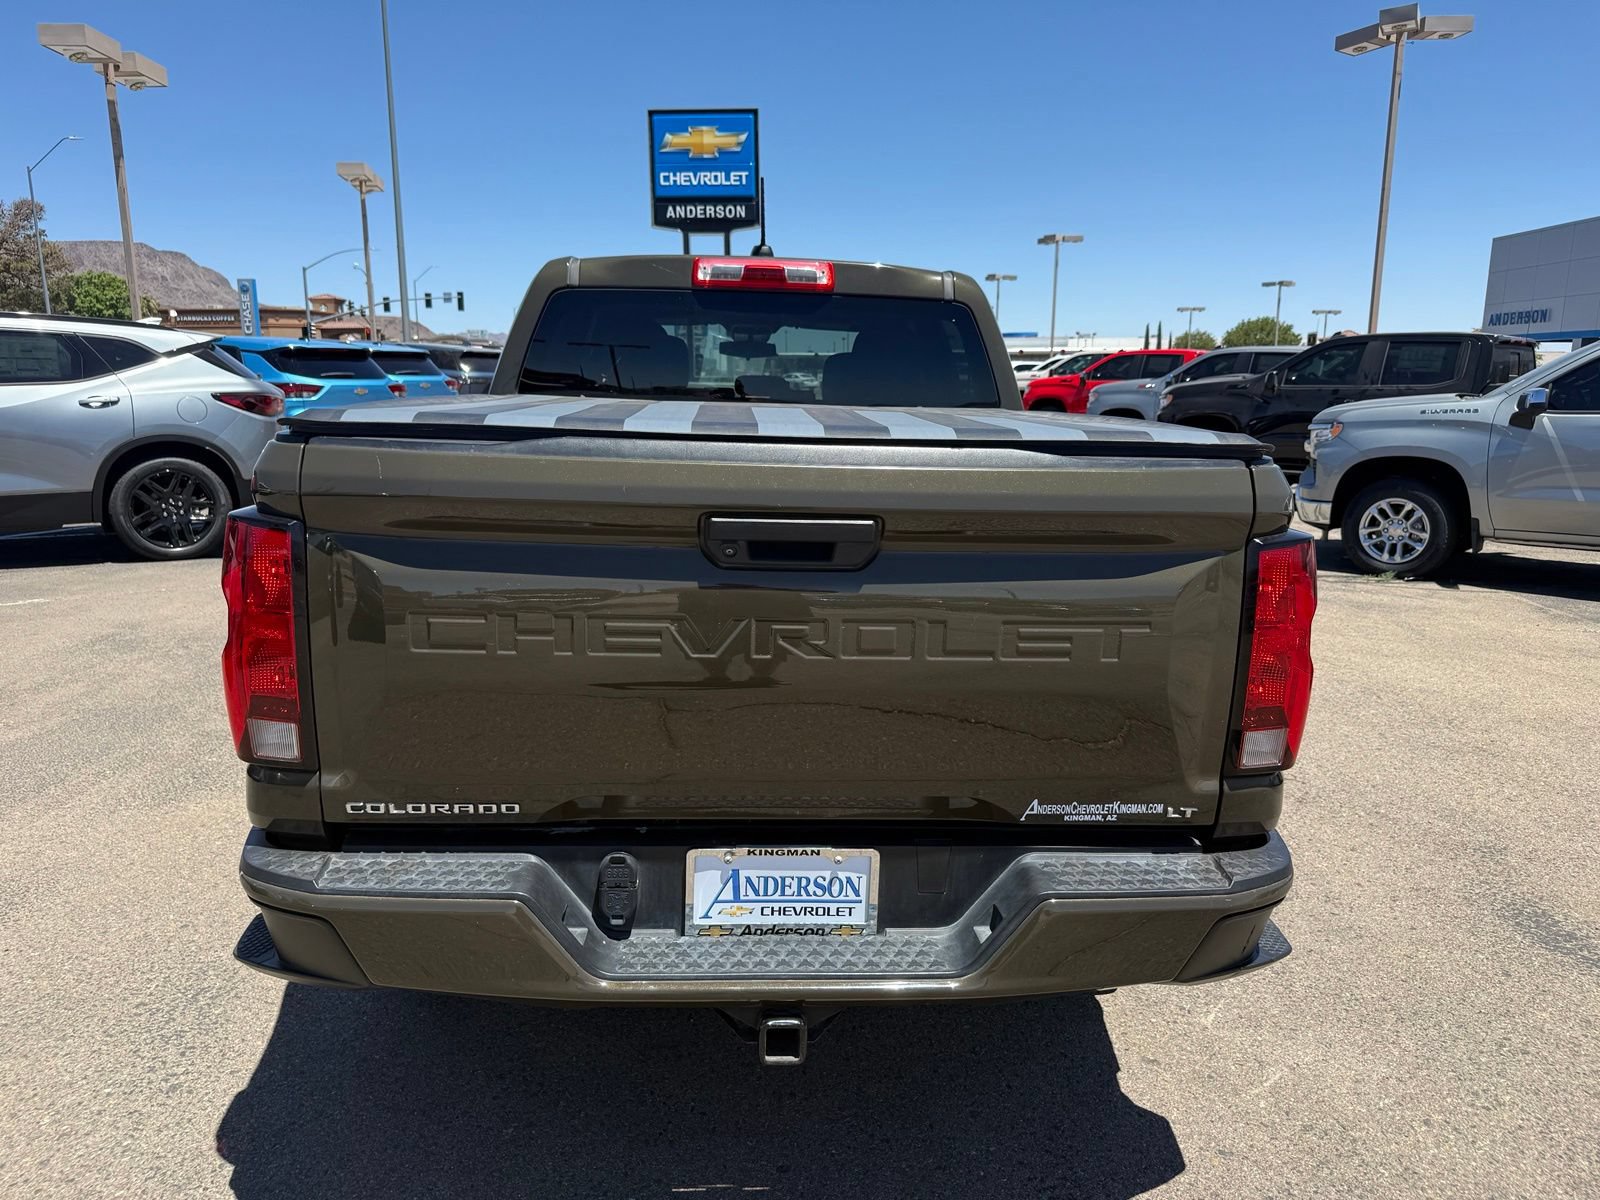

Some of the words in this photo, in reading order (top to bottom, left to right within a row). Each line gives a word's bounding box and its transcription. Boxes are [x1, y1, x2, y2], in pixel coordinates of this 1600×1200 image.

[660, 171, 749, 186] CHEVROLET
[666, 205, 746, 219] ANDERSON
[241, 294, 253, 335] CHASE
[1488, 308, 1548, 326] ANDERSON
[407, 611, 1151, 663] CHEVROLET
[345, 802, 520, 814] COLORADO
[1166, 807, 1199, 818] LT
[1063, 814, 1104, 822] KINGMAN,
[747, 848, 821, 857] KINGMAN
[699, 868, 863, 920] ANDERSON
[760, 906, 856, 917] CHEVROLET
[739, 924, 826, 936] Anderson
